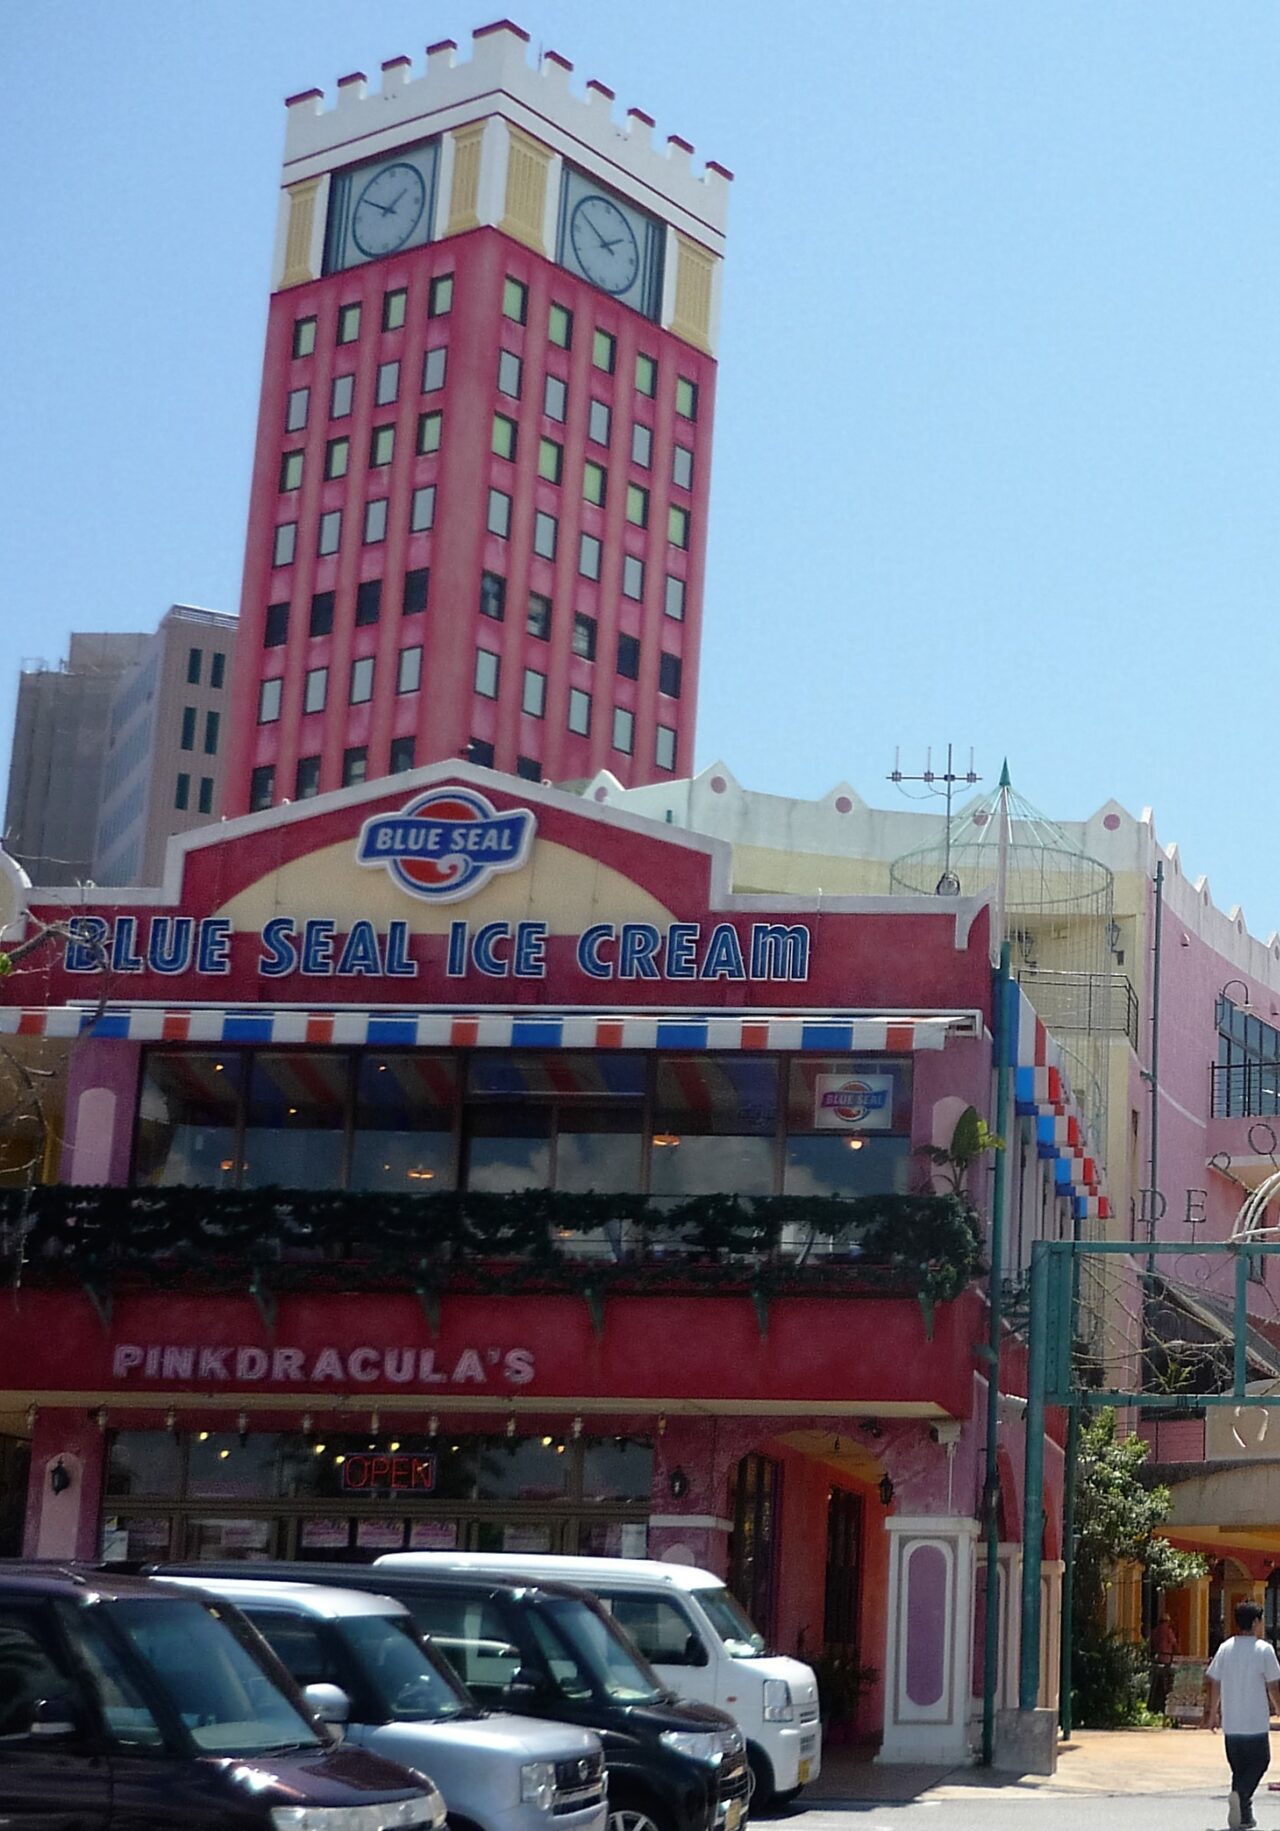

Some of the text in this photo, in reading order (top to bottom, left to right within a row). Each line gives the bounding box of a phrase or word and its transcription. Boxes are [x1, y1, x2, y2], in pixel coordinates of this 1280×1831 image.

[376, 828, 513, 851] BLUE SEAL
[63, 915, 234, 976] BLUE
[258, 917, 418, 978] SEAL
[446, 919, 548, 979] ICE
[113, 1343, 535, 1384] PINKDRACULA'S
[344, 1455, 433, 1489] OPEN
